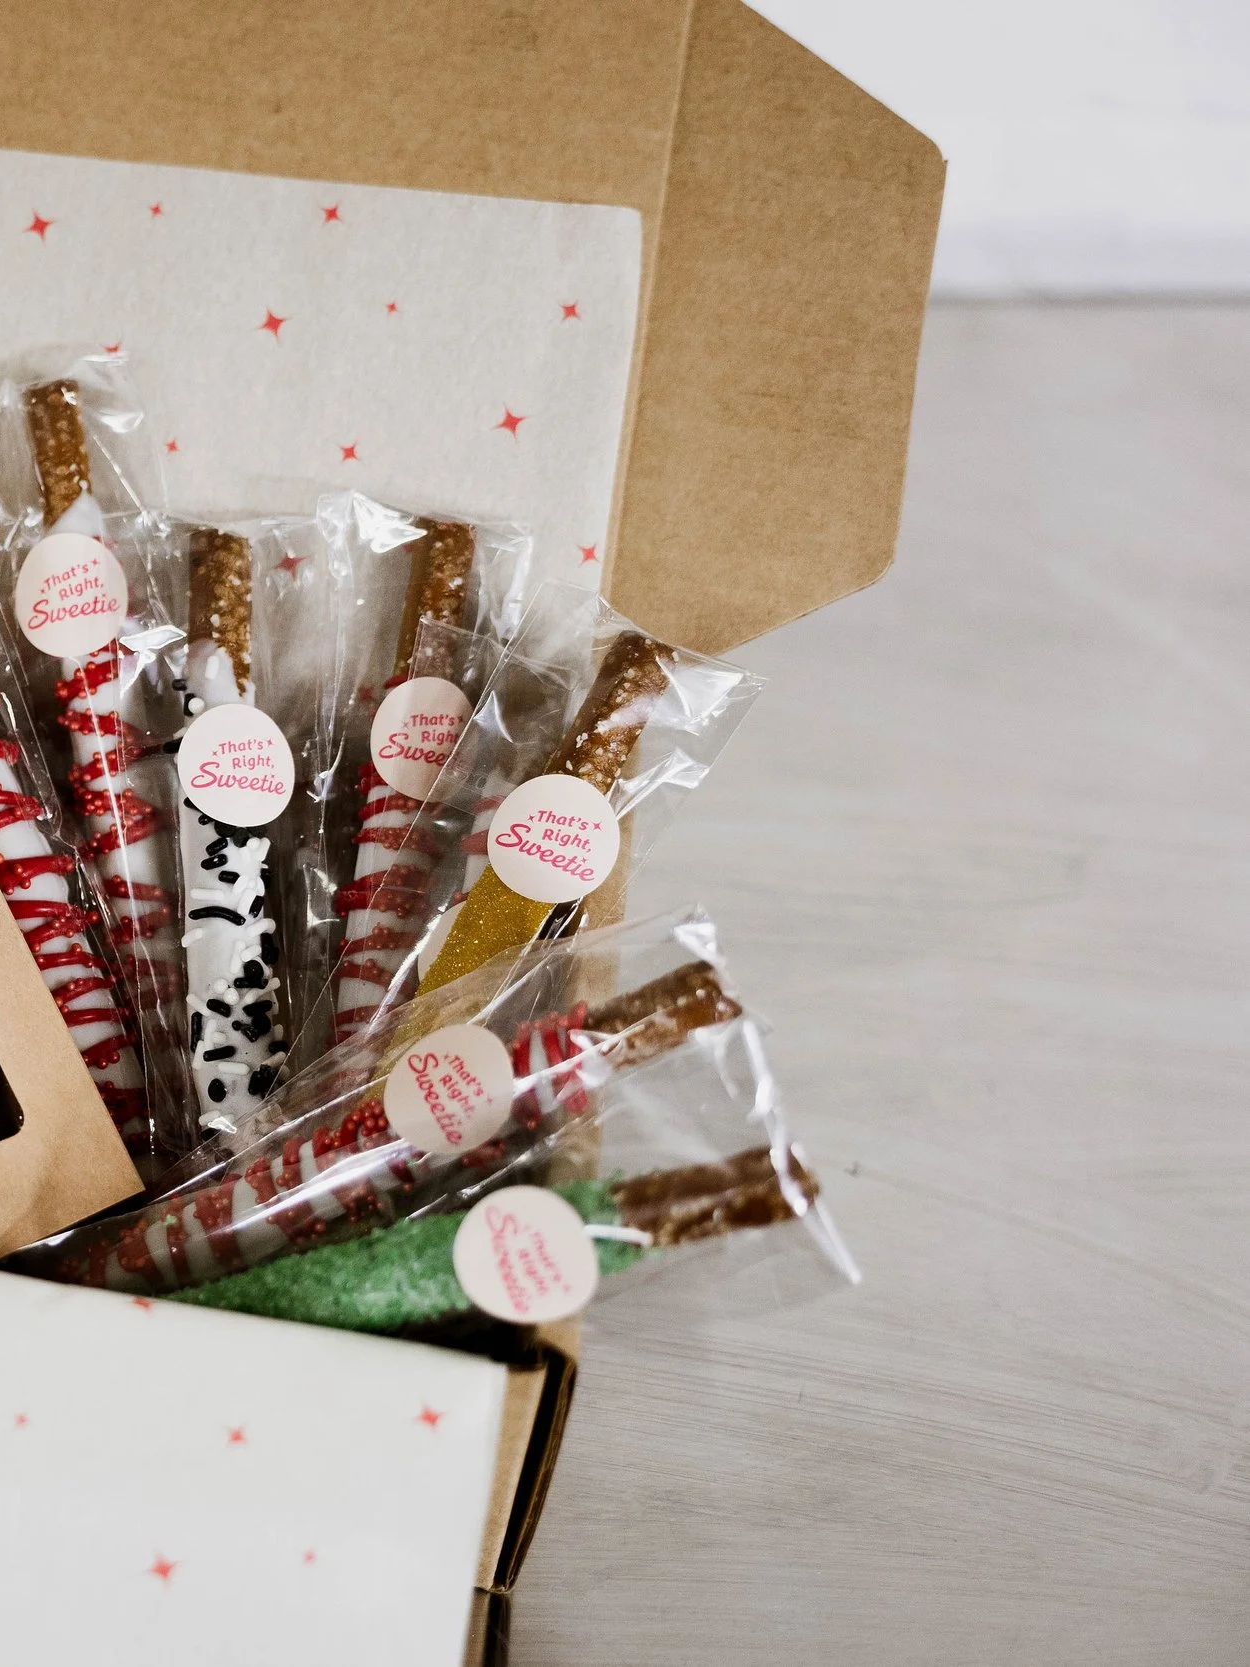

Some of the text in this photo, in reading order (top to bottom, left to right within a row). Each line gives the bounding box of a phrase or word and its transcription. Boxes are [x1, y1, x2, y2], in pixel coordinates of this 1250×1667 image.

[44, 565, 88, 590] That's
[28, 594, 120, 630] Sweetie
[411, 714, 454, 726] That's
[219, 739, 263, 754] That's
[232, 755, 274, 770] Right,
[191, 762, 286, 794] Sweetie
[537, 810, 588, 830] That's
[495, 824, 594, 881] Sweetie
[542, 829, 591, 853] Right,
[449, 1055, 483, 1096] That's
[407, 1053, 462, 1144] Sweetie
